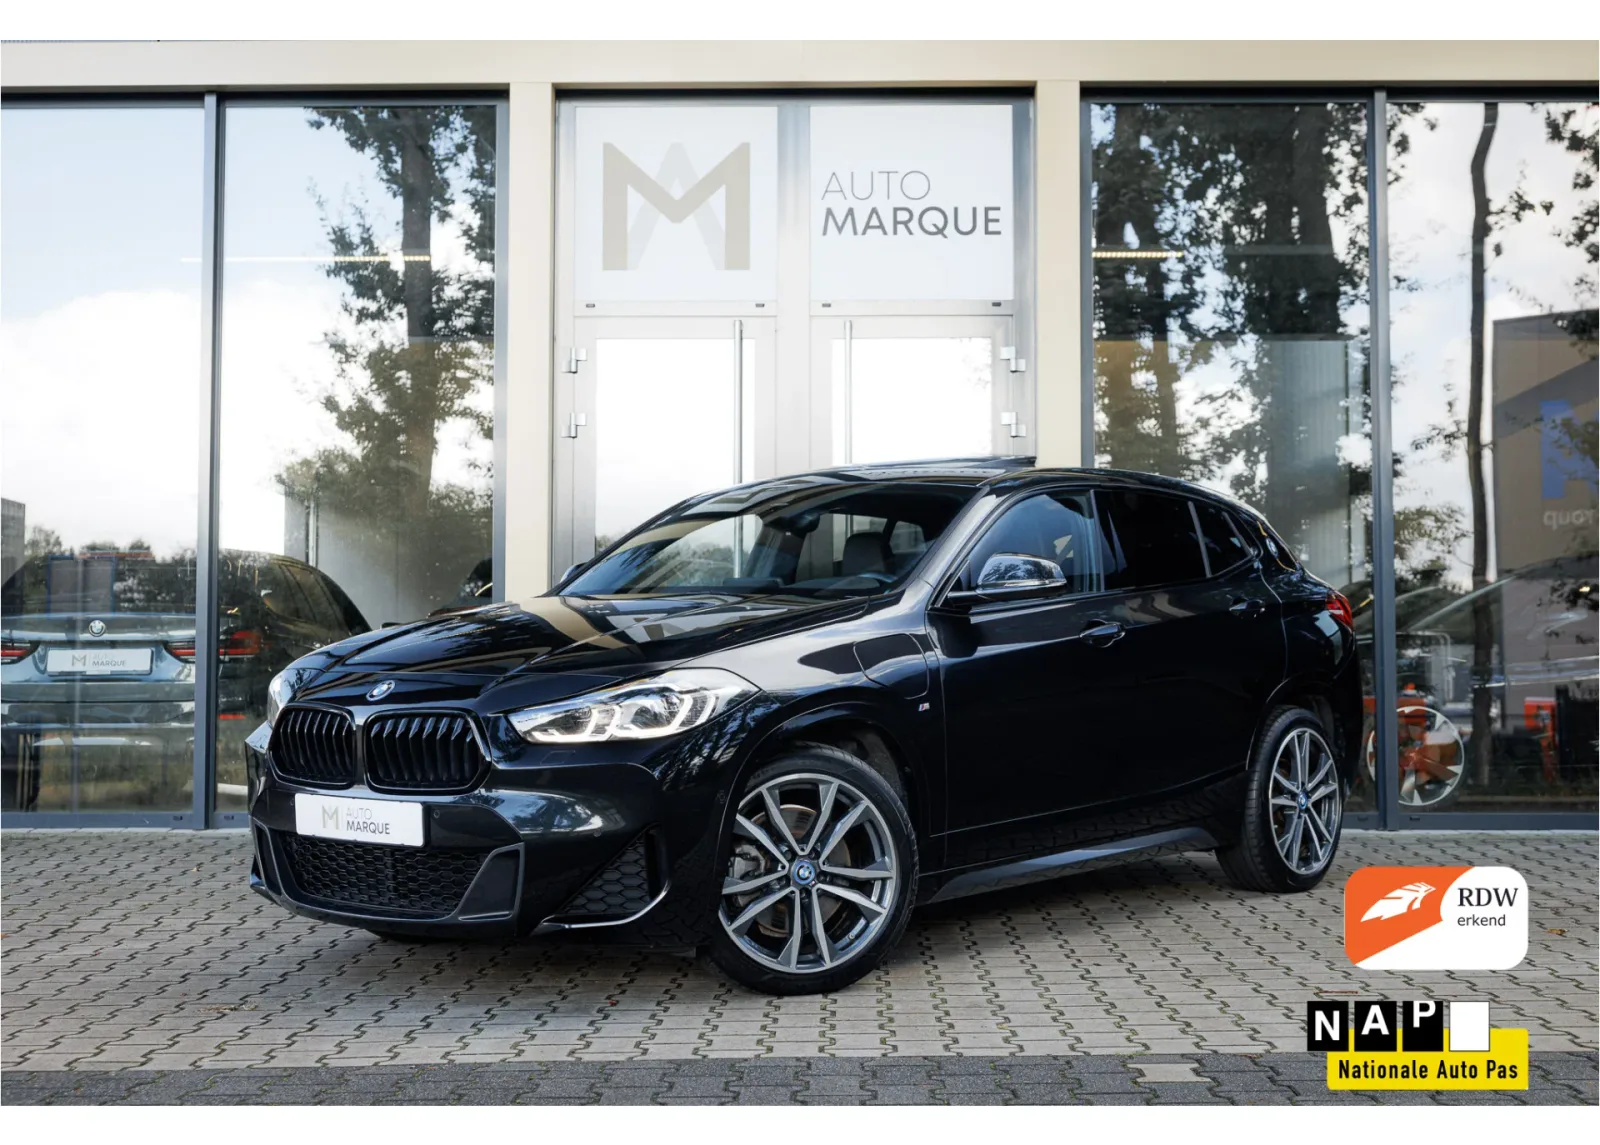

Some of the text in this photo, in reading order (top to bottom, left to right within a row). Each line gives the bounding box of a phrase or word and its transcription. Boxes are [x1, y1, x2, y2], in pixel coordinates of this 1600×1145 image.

[821, 170, 931, 201] AUTO
[822, 206, 1002, 239] MARQUE
[346, 807, 373, 820] AUTO
[346, 820, 391, 835] MARQUE
